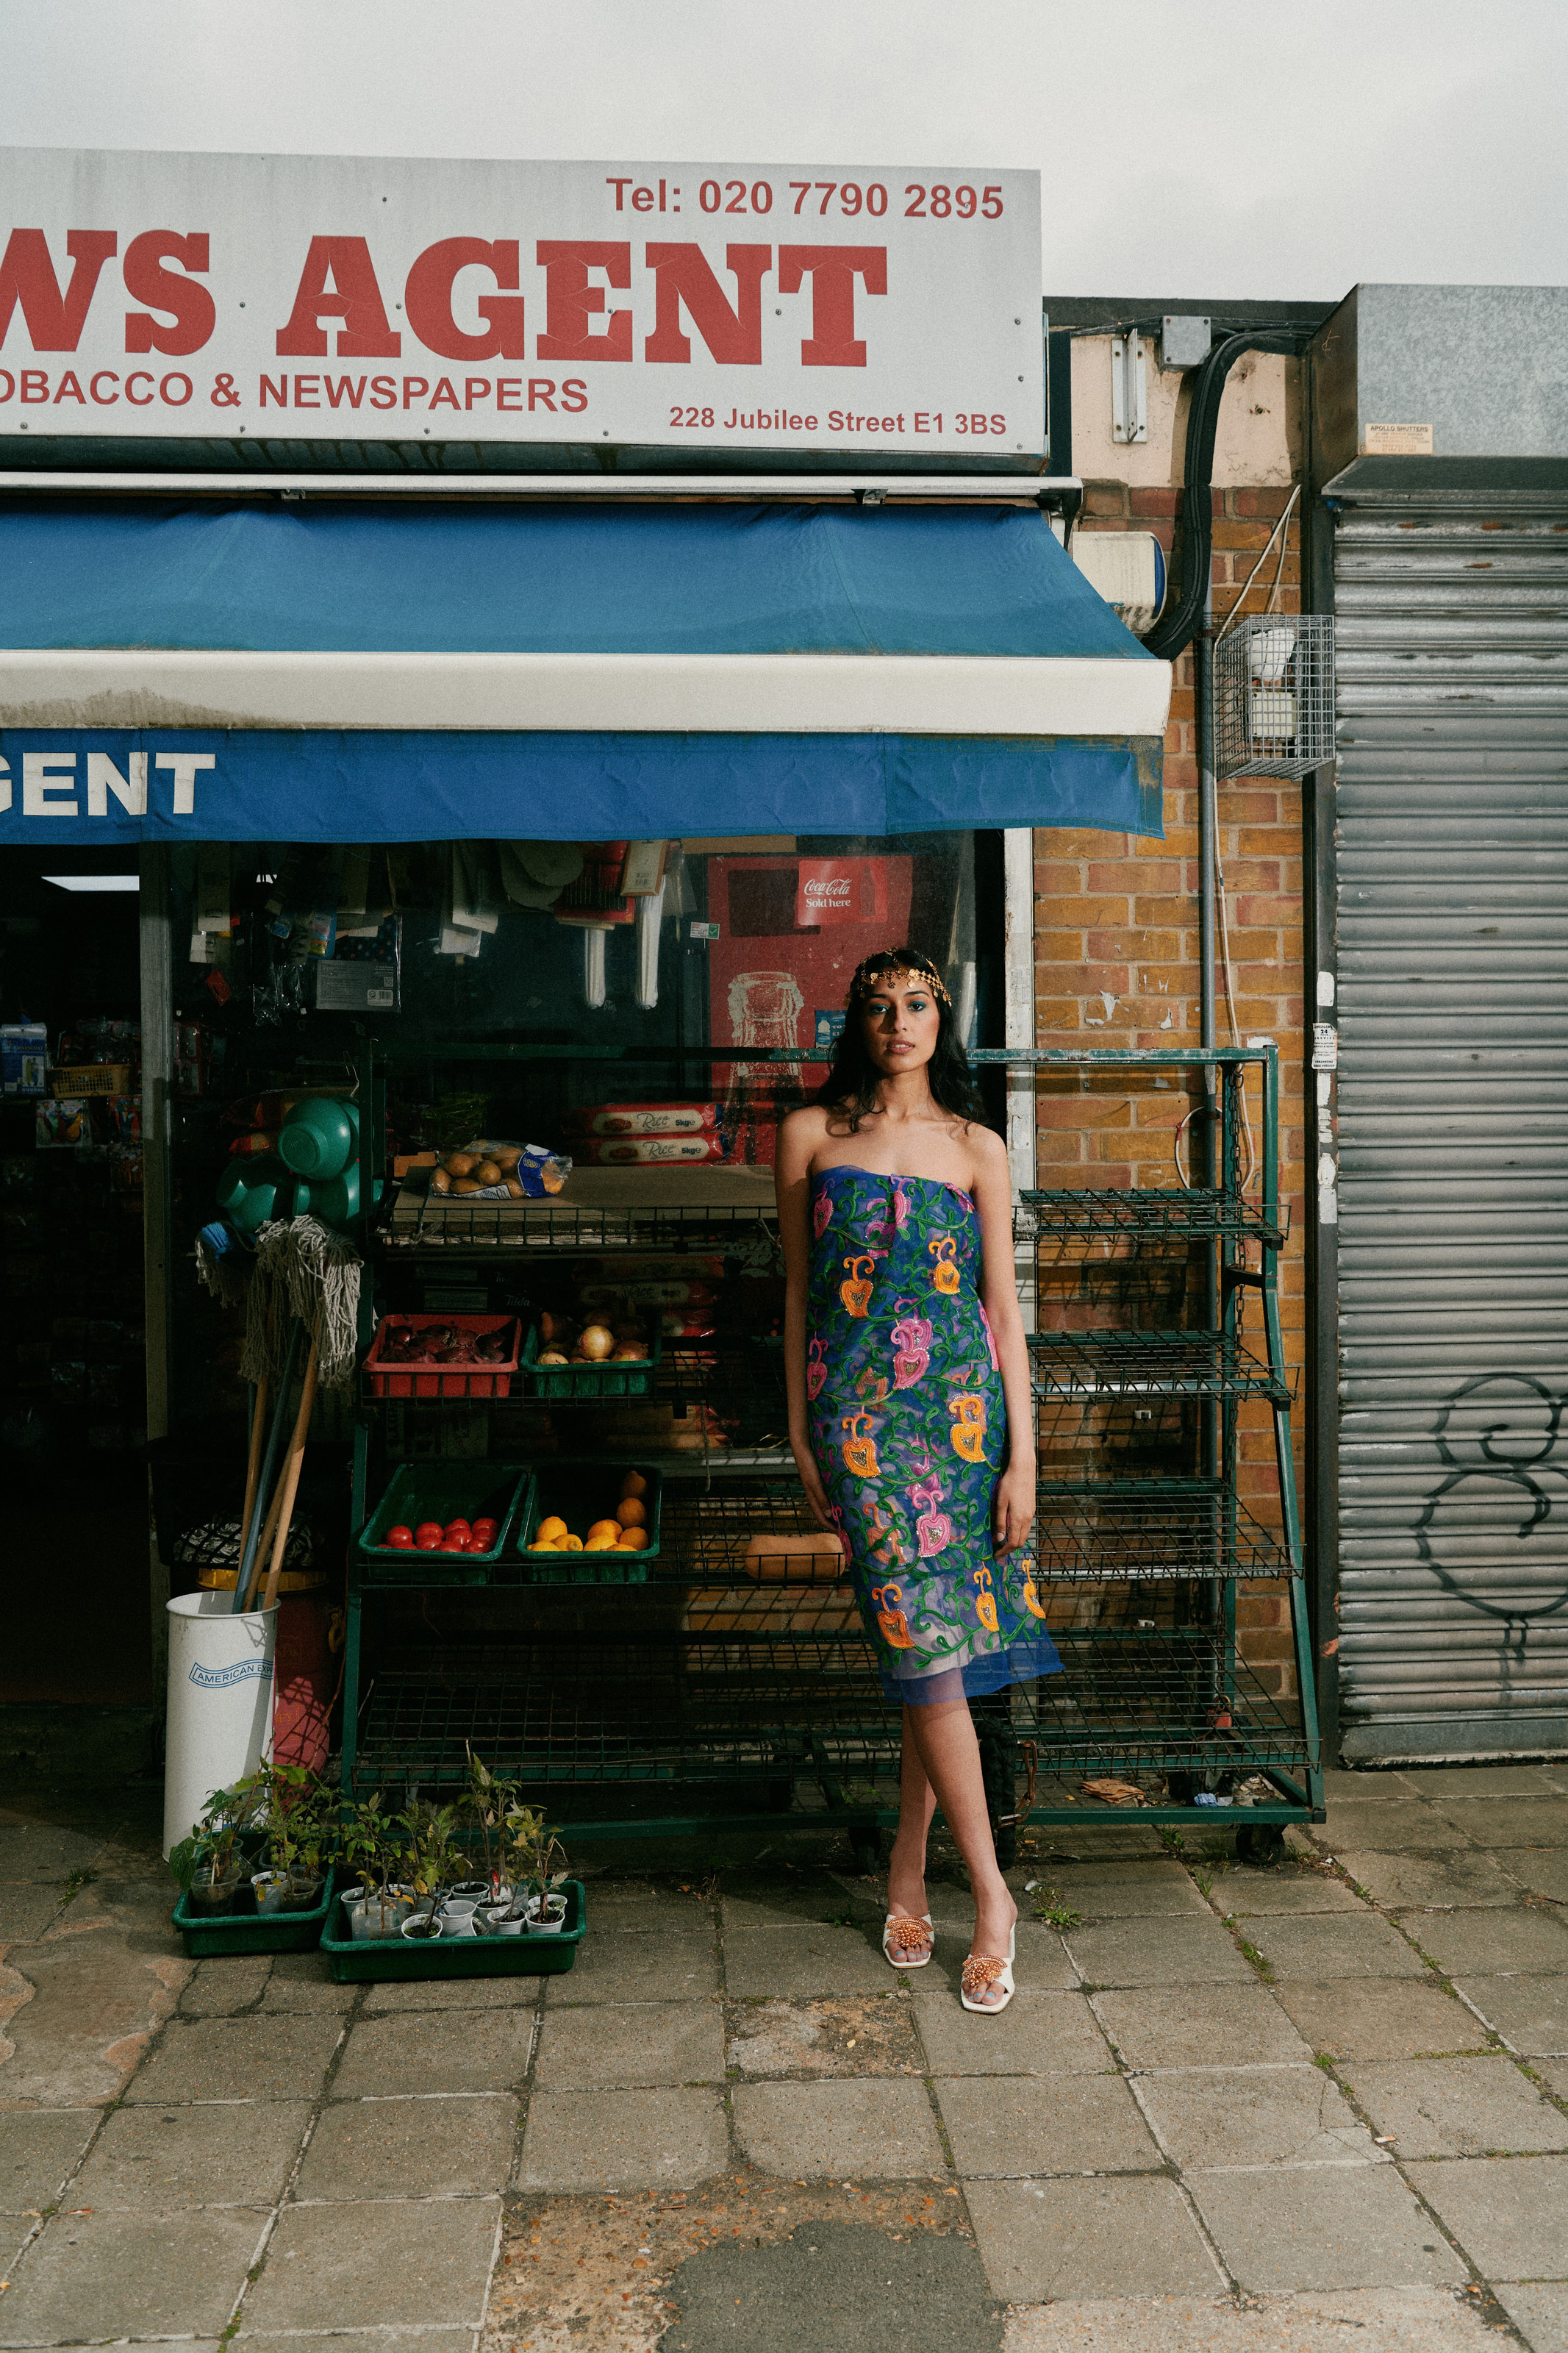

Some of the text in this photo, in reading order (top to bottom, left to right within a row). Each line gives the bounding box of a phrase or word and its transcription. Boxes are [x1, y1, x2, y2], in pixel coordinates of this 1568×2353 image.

[606, 179, 1004, 220] Tel: 020 7790 2895
[276, 235, 887, 367] AGENT
[211, 374, 242, 407] &
[259, 375, 588, 413] NEWSPAPERS
[670, 407, 1006, 435] 228 Jubilee Street E1 3BS
[0, 751, 216, 816] ENT
[803, 878, 852, 896] Coca-Cola
[806, 898, 851, 908] Sold here
[637, 1113, 670, 1129] Rice
[642, 1141, 676, 1158] Rice
[197, 1665, 254, 1683] AMERICAN
